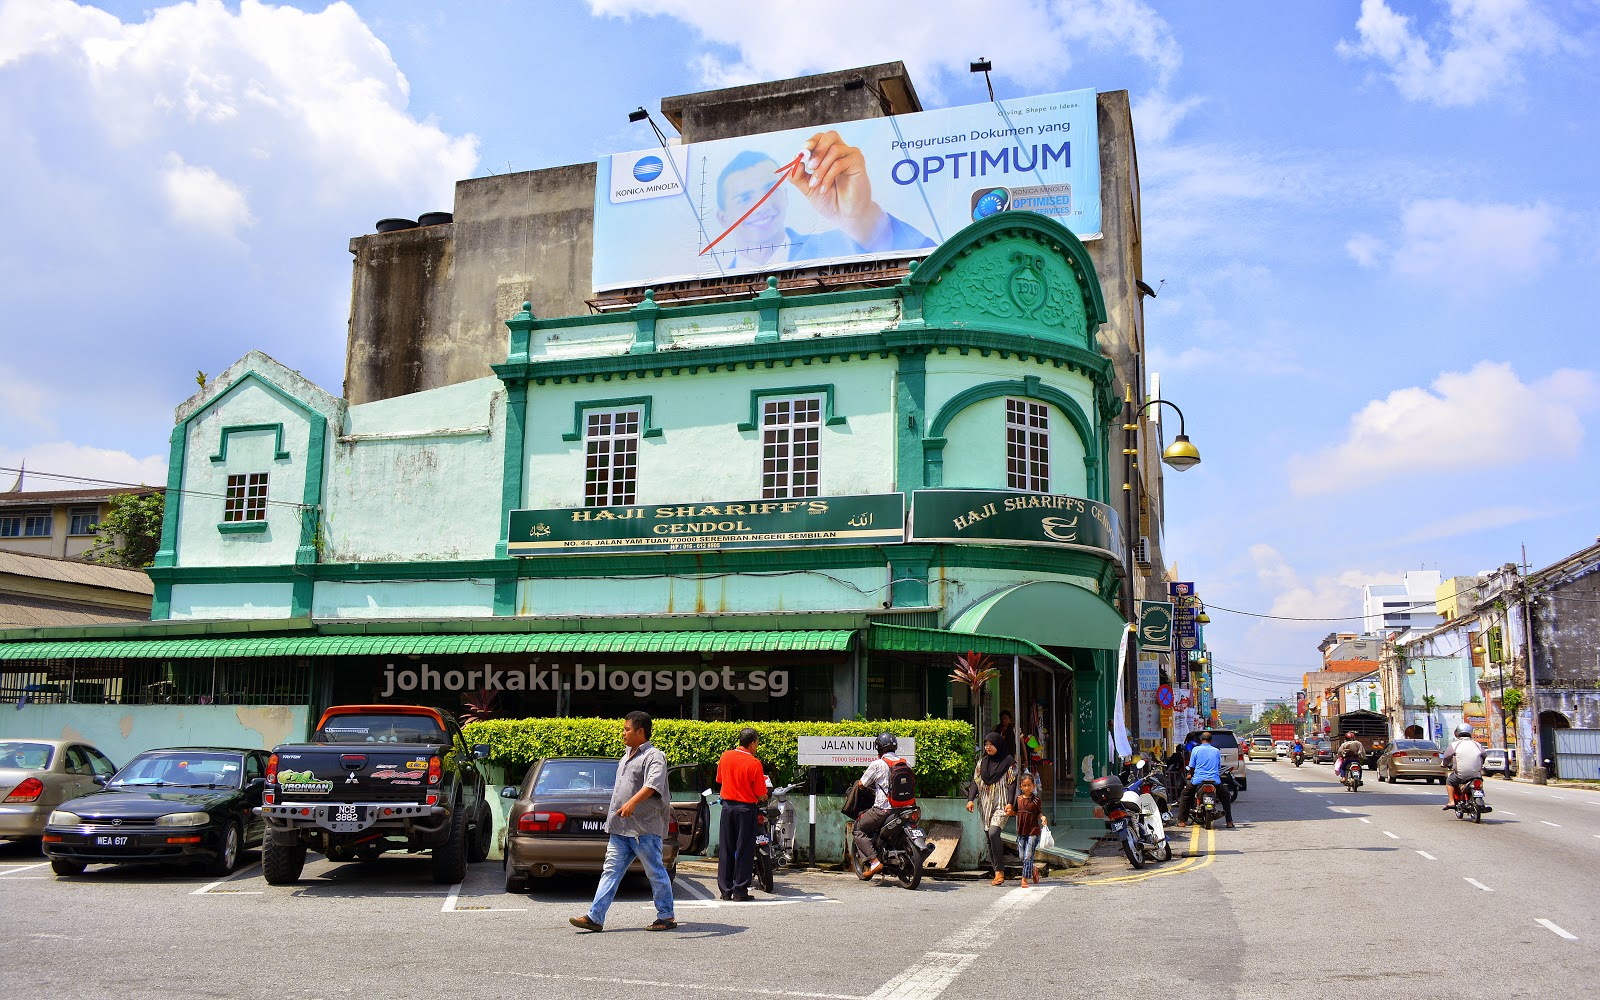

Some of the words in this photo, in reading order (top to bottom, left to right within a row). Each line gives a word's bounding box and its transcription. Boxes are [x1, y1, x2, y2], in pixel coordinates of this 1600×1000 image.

[998, 109, 1022, 117] Giving
[1025, 106, 1047, 114] Shape
[891, 133, 966, 151] Pengurusan
[970, 125, 1034, 141] Dokumen
[1037, 122, 1071, 135] yang
[891, 141, 1072, 186] OPTIMUM
[615, 187, 645, 198] KONICA
[645, 182, 680, 193] MINOLTA
[1012, 188, 1039, 196] KONICA
[1040, 185, 1070, 193] MINOLTA
[1013, 195, 1070, 209] OPTIMISED
[1035, 206, 1070, 215] SERVICES
[571, 508, 645, 522] HAJI
[654, 501, 830, 519] SHARIFF'S
[953, 502, 998, 531] HAJI
[1004, 495, 1085, 514] SHARIFF'S
[652, 520, 752, 535] CENDOL
[788, 531, 837, 539] SEMBILAN
[821, 740, 854, 750] JALAN
[338, 805, 356, 813] NCB
[335, 813, 358, 821] 3882
[582, 821, 599, 831] NAN
[115, 836, 129, 845] 617
